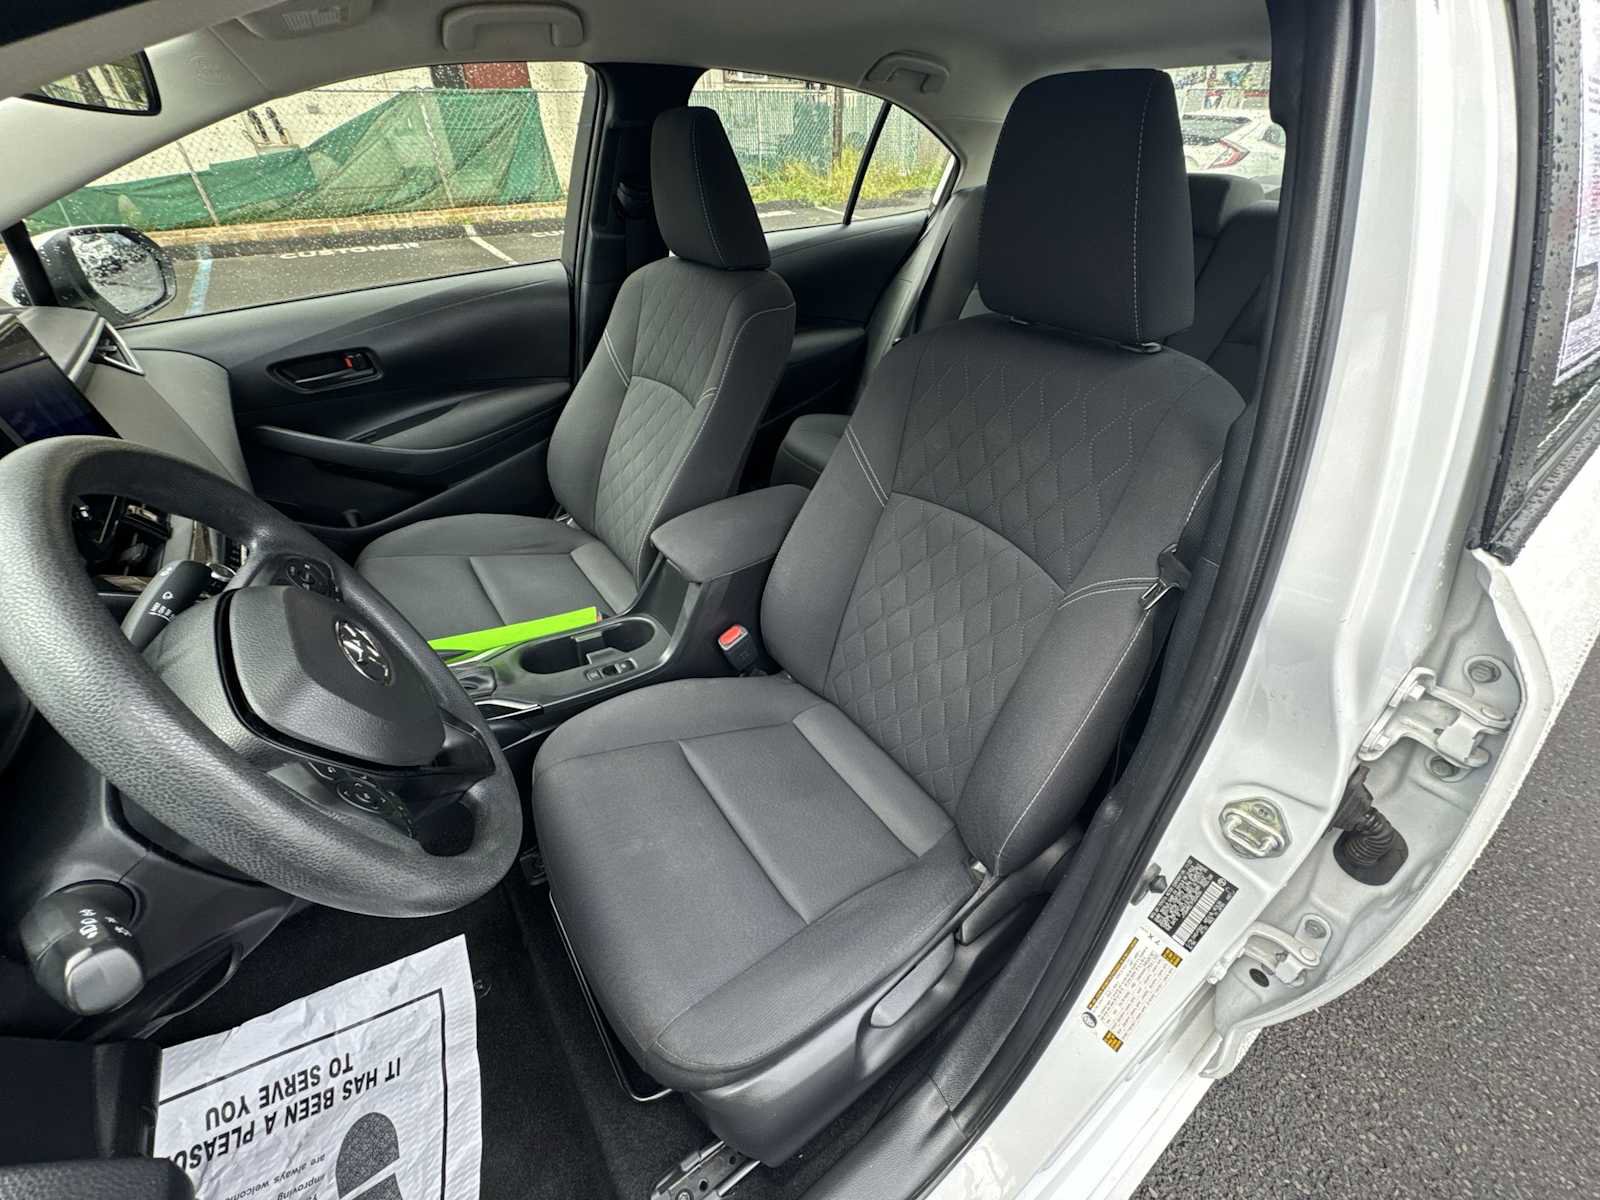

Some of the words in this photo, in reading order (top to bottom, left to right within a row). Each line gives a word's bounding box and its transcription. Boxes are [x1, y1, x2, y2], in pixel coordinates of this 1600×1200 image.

[280, 242, 422, 259] CUSTOMER
[329, 1053, 354, 1078] TO
[385, 1057, 400, 1082] IT
[258, 1064, 321, 1109] SERVE
[342, 1067, 378, 1101] HAS
[205, 1094, 251, 1132] YOU
[284, 1087, 335, 1128] BEEN
[264, 1111, 278, 1135] A
[172, 1119, 255, 1171] PLEASU
[310, 1153, 326, 1166] are
[273, 1162, 307, 1184] always
